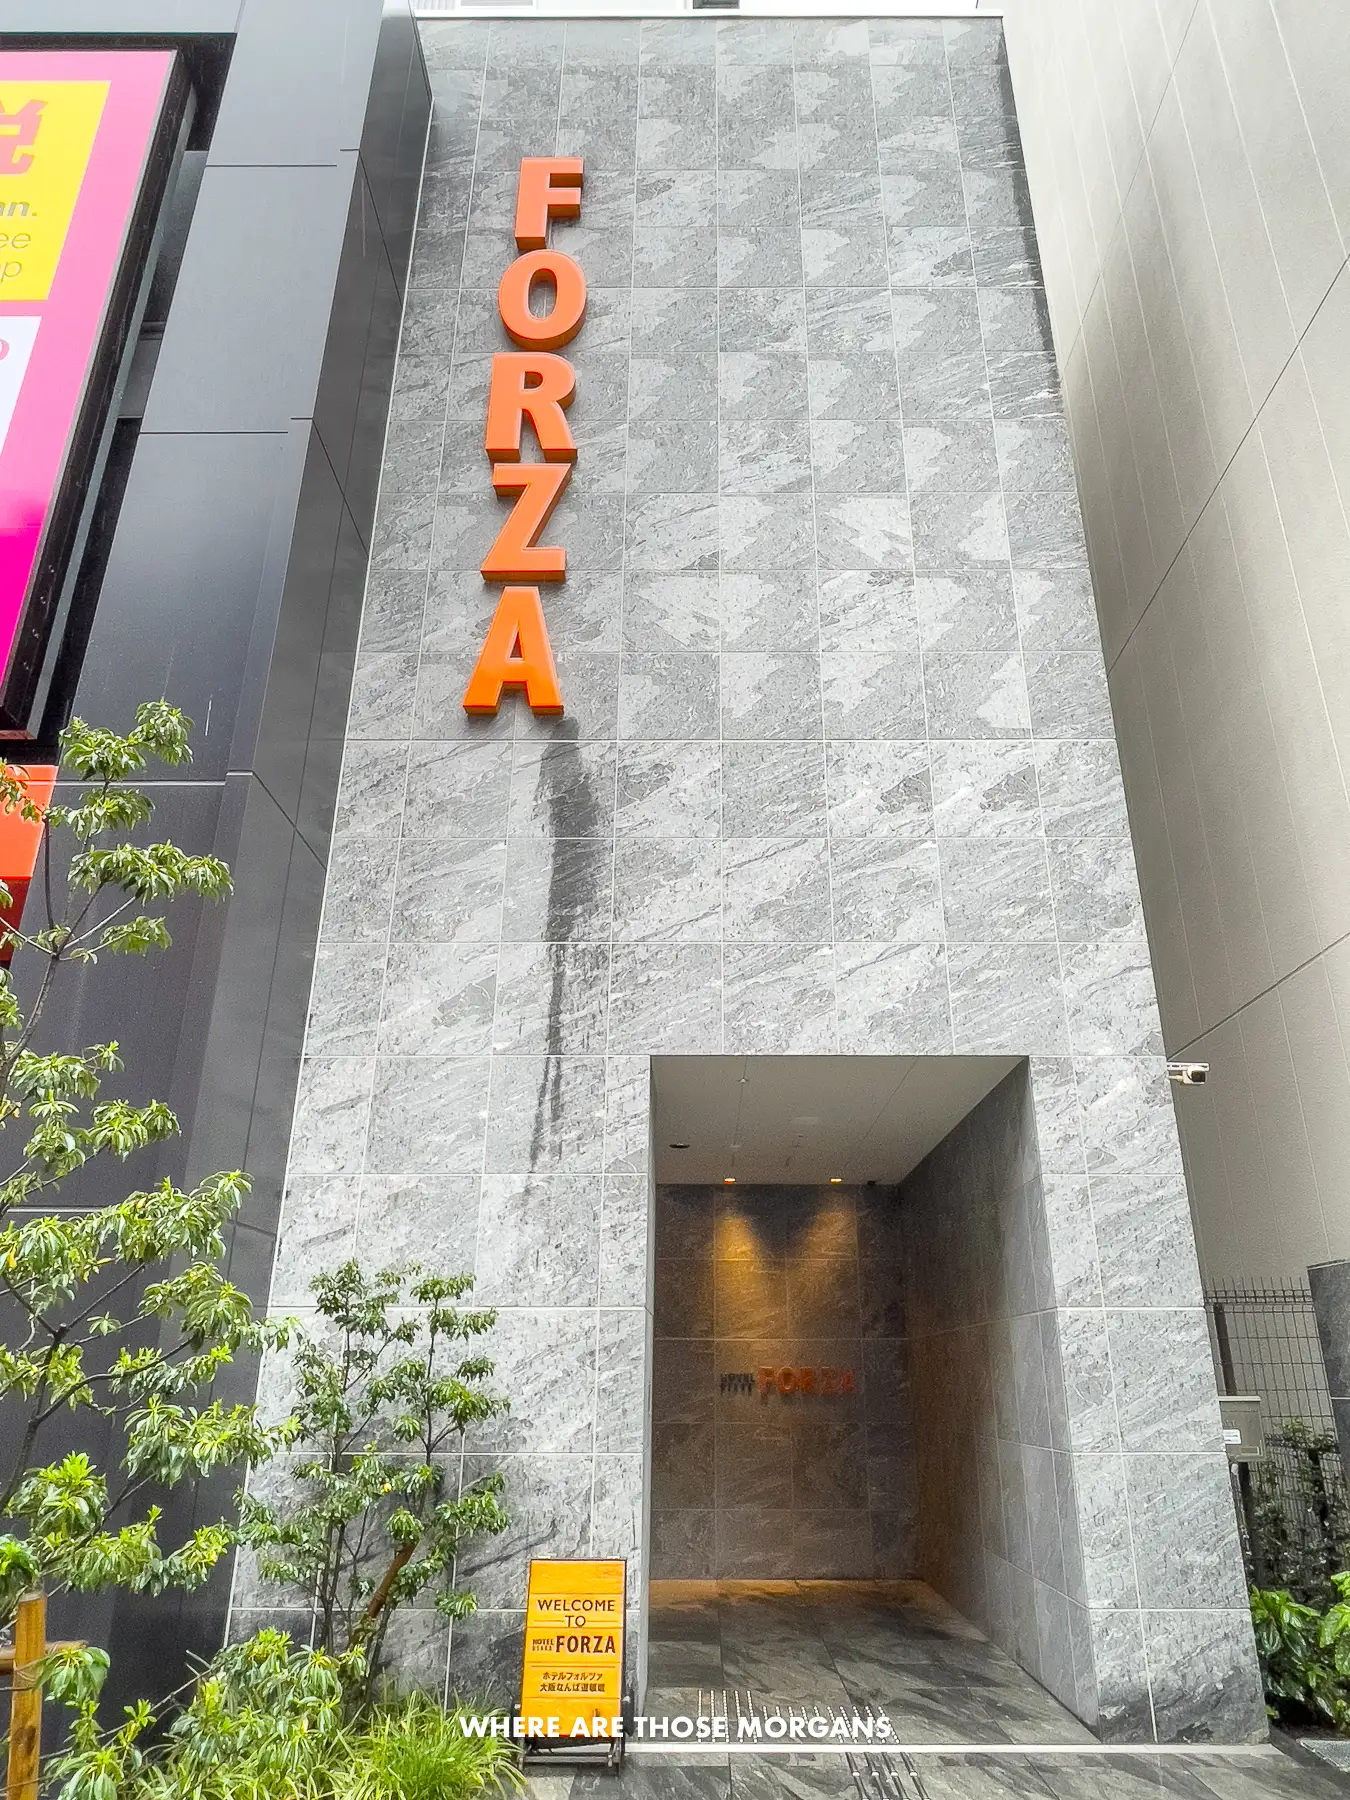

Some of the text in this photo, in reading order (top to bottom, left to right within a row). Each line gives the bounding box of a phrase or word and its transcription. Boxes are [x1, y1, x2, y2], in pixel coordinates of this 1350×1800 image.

[462, 156, 587, 717] FORZA
[537, 1599, 616, 1612] WELCOME
[564, 1615, 586, 1628] TO
[555, 1635, 616, 1653] FORZA
